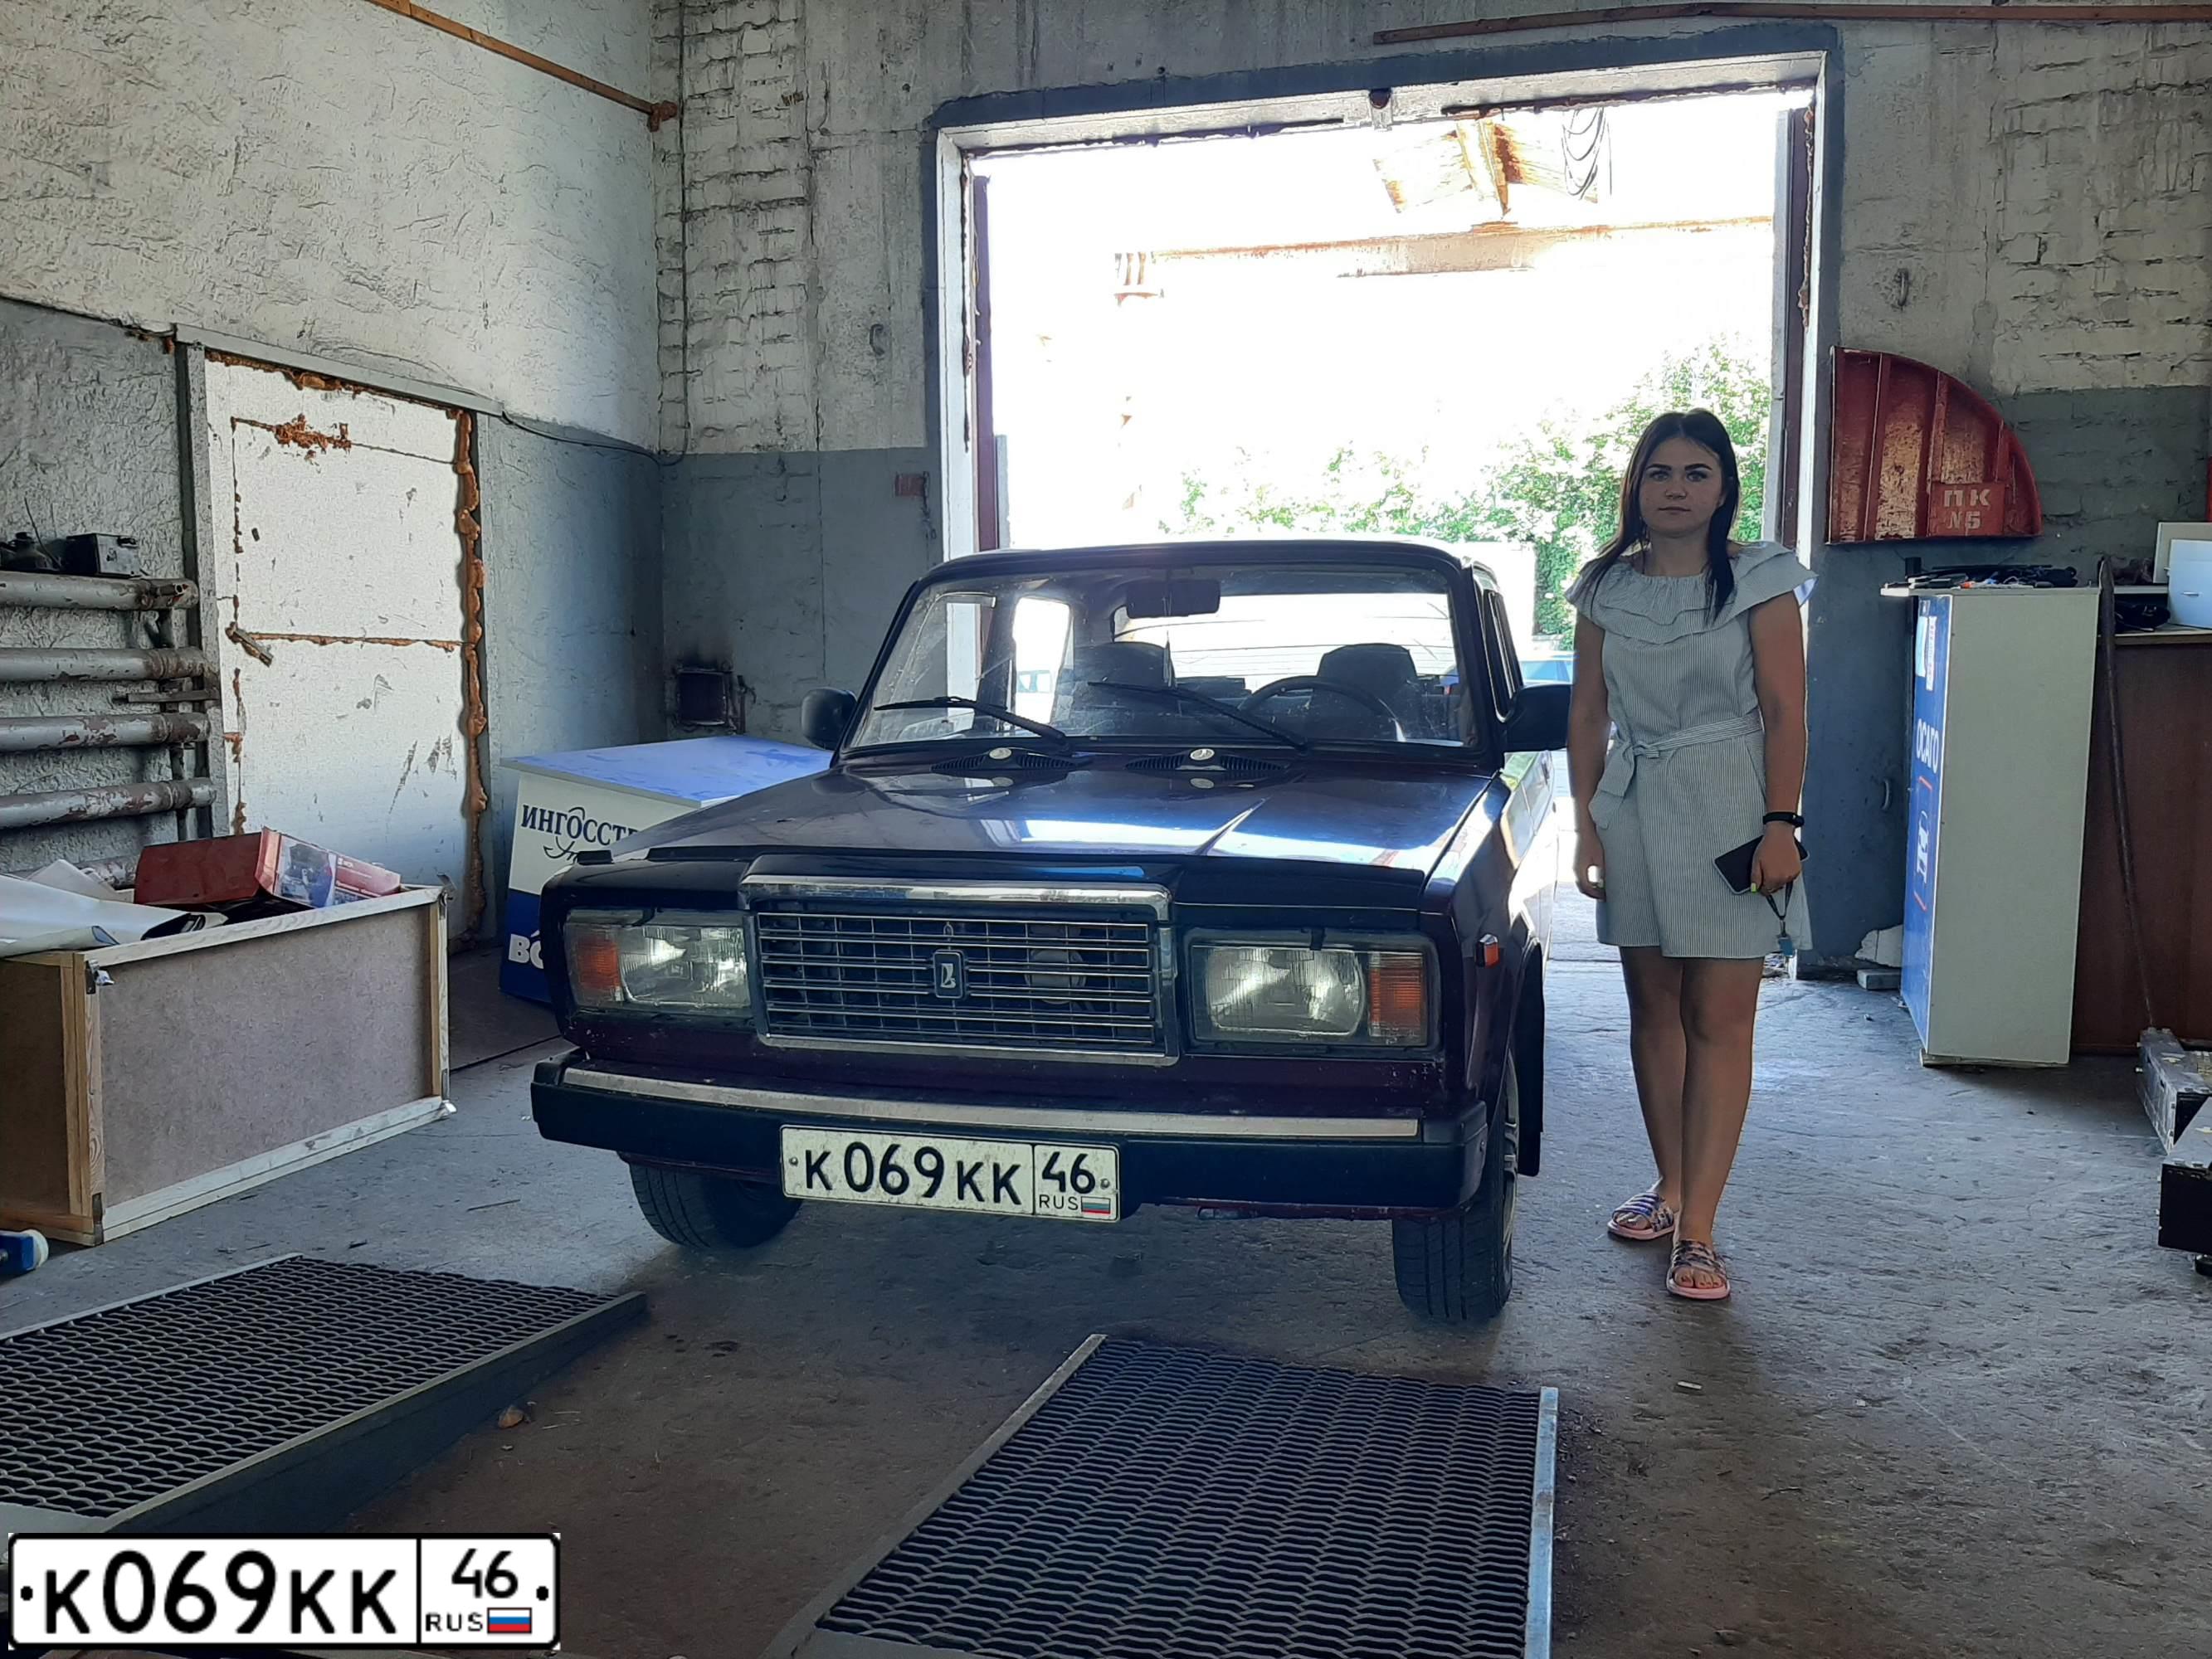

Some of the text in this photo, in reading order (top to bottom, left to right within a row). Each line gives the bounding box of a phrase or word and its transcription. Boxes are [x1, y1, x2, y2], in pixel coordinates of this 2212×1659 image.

[1944, 489, 1990, 508] ПК
[1042, 1151, 1095, 1194] 46
[1040, 1194, 1078, 1210] RUS
